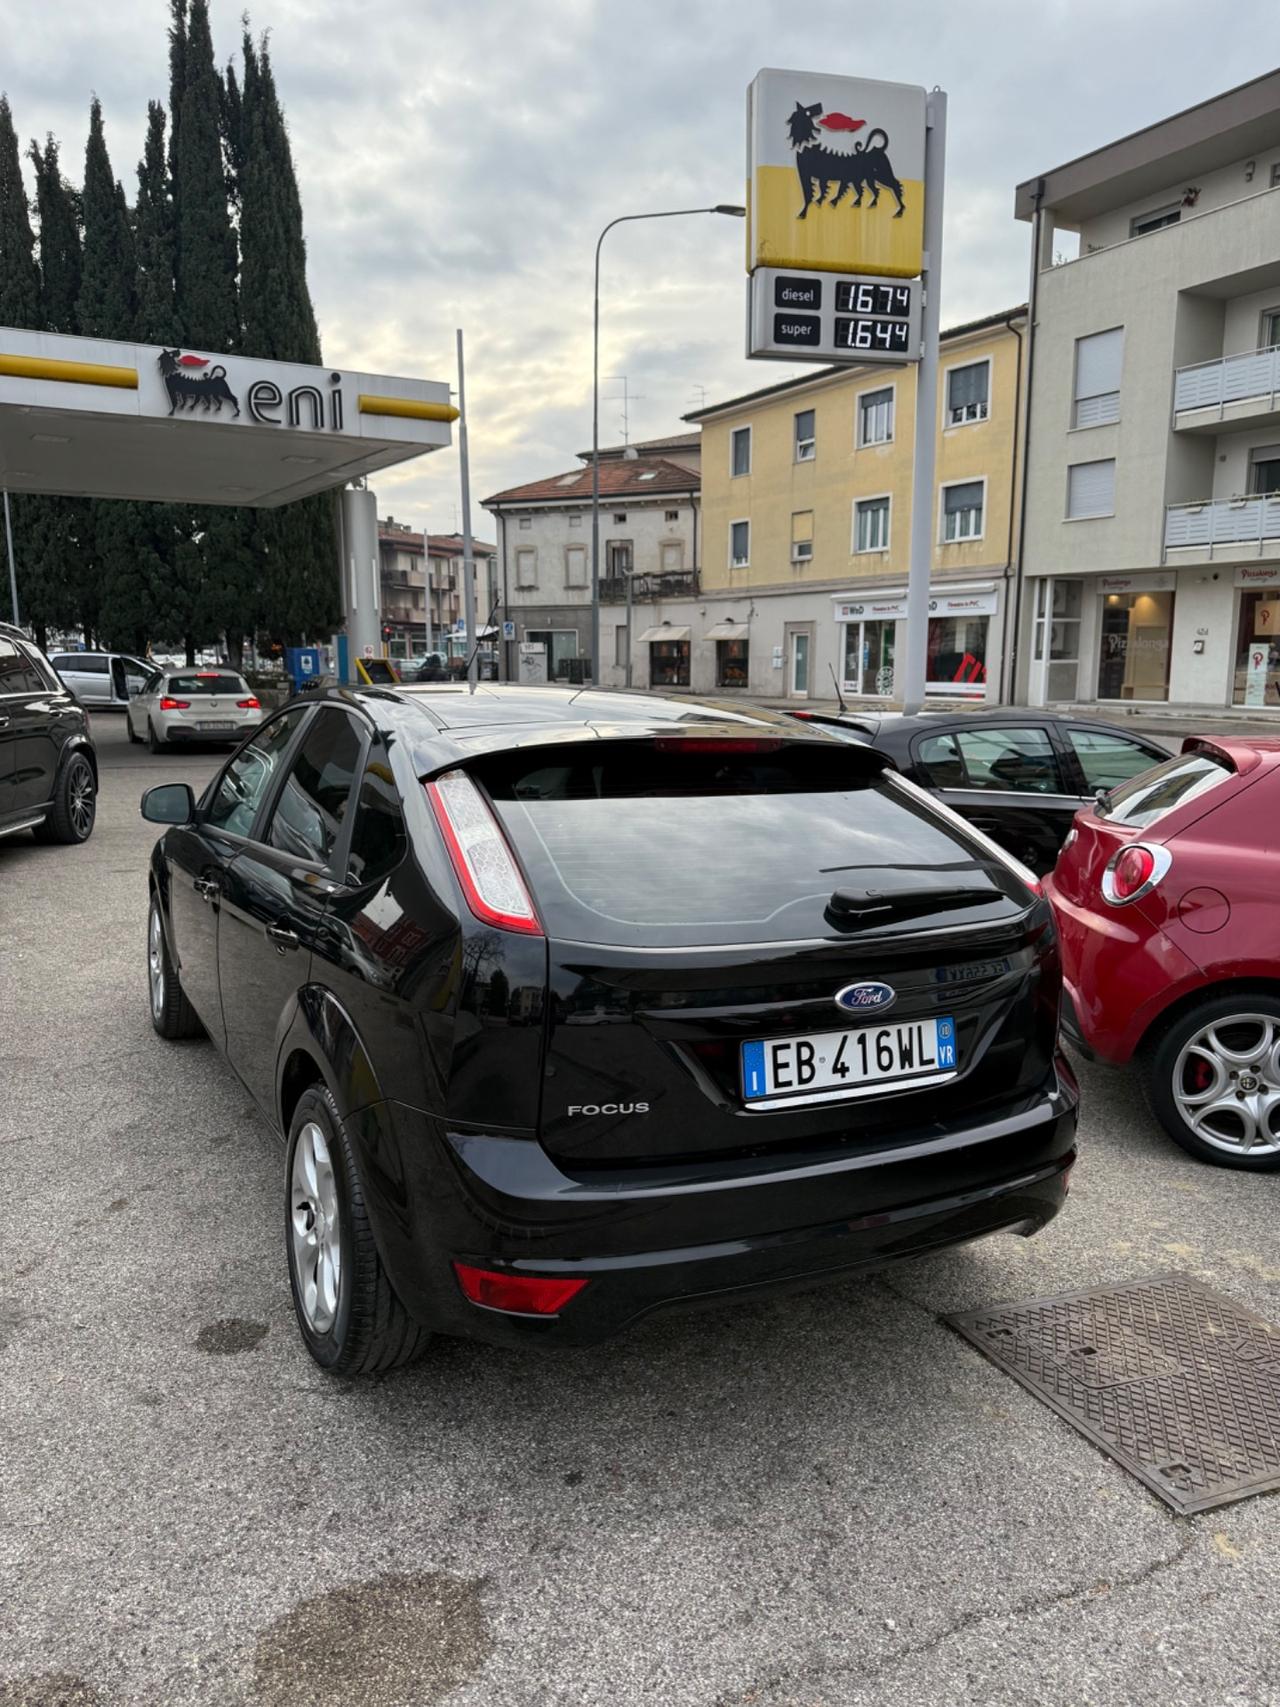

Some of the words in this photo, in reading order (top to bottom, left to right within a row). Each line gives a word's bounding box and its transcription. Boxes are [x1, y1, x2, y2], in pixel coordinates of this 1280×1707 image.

[781, 289, 814, 302] diesel
[780, 323, 813, 336] super
[248, 372, 343, 430] eni
[850, 987, 883, 1005] Ford
[939, 1045, 954, 1065] VR
[567, 1102, 650, 1117] FOCUS
